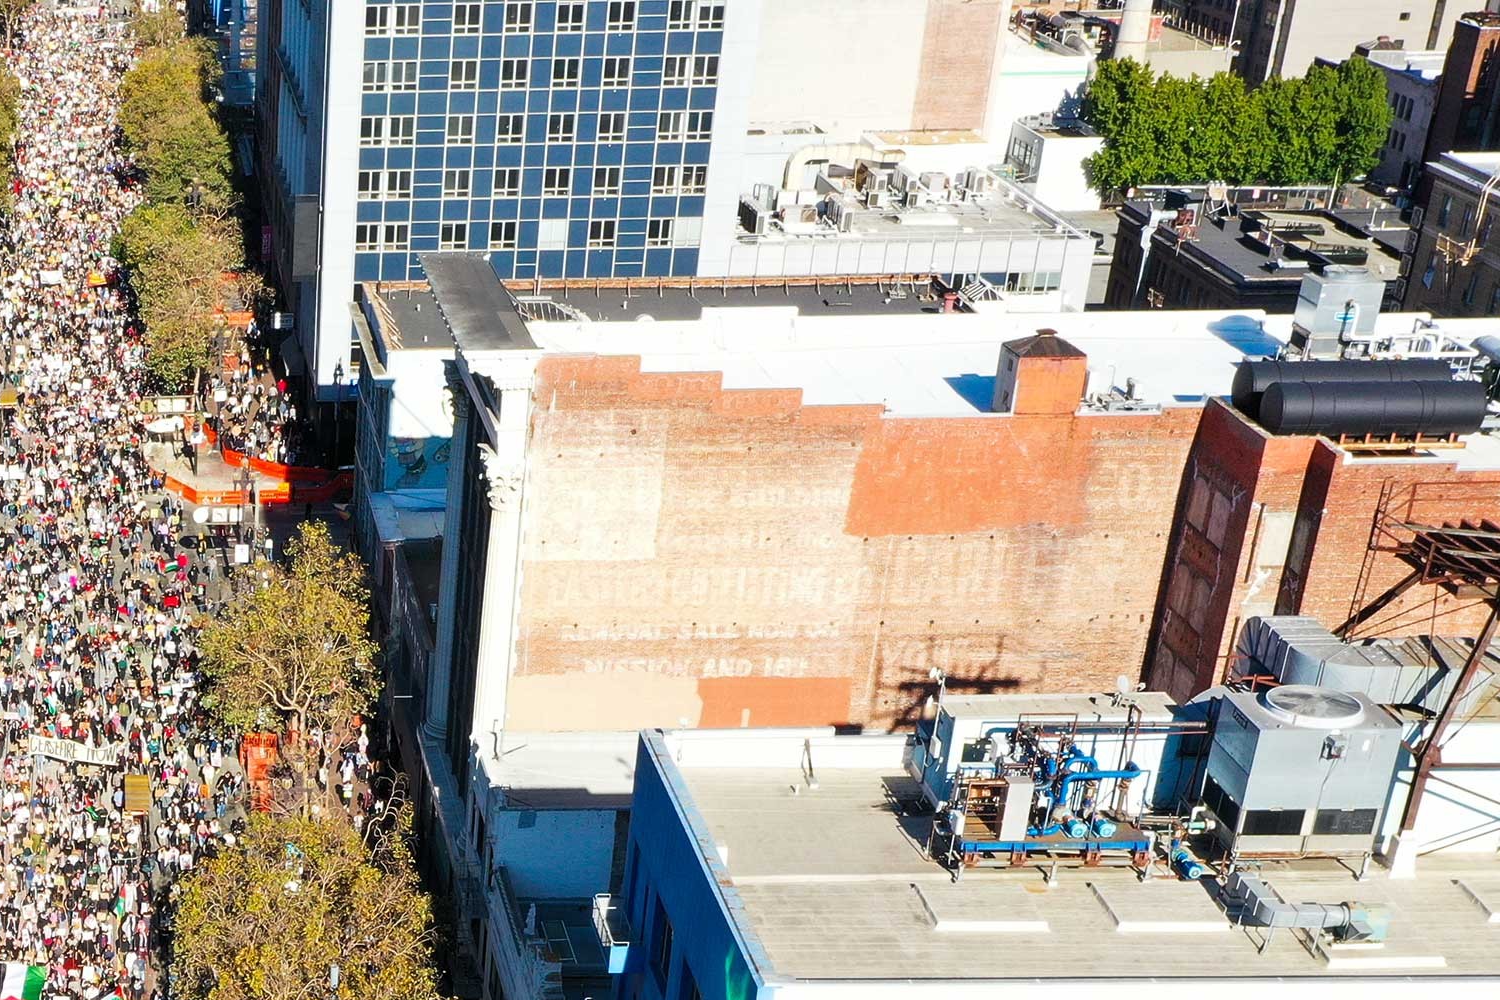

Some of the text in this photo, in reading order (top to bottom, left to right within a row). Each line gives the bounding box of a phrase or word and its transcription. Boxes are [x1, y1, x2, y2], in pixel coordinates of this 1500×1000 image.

[676, 623, 740, 640] SALE
[701, 656, 753, 678] AND
[86, 745, 117, 762] NOW
